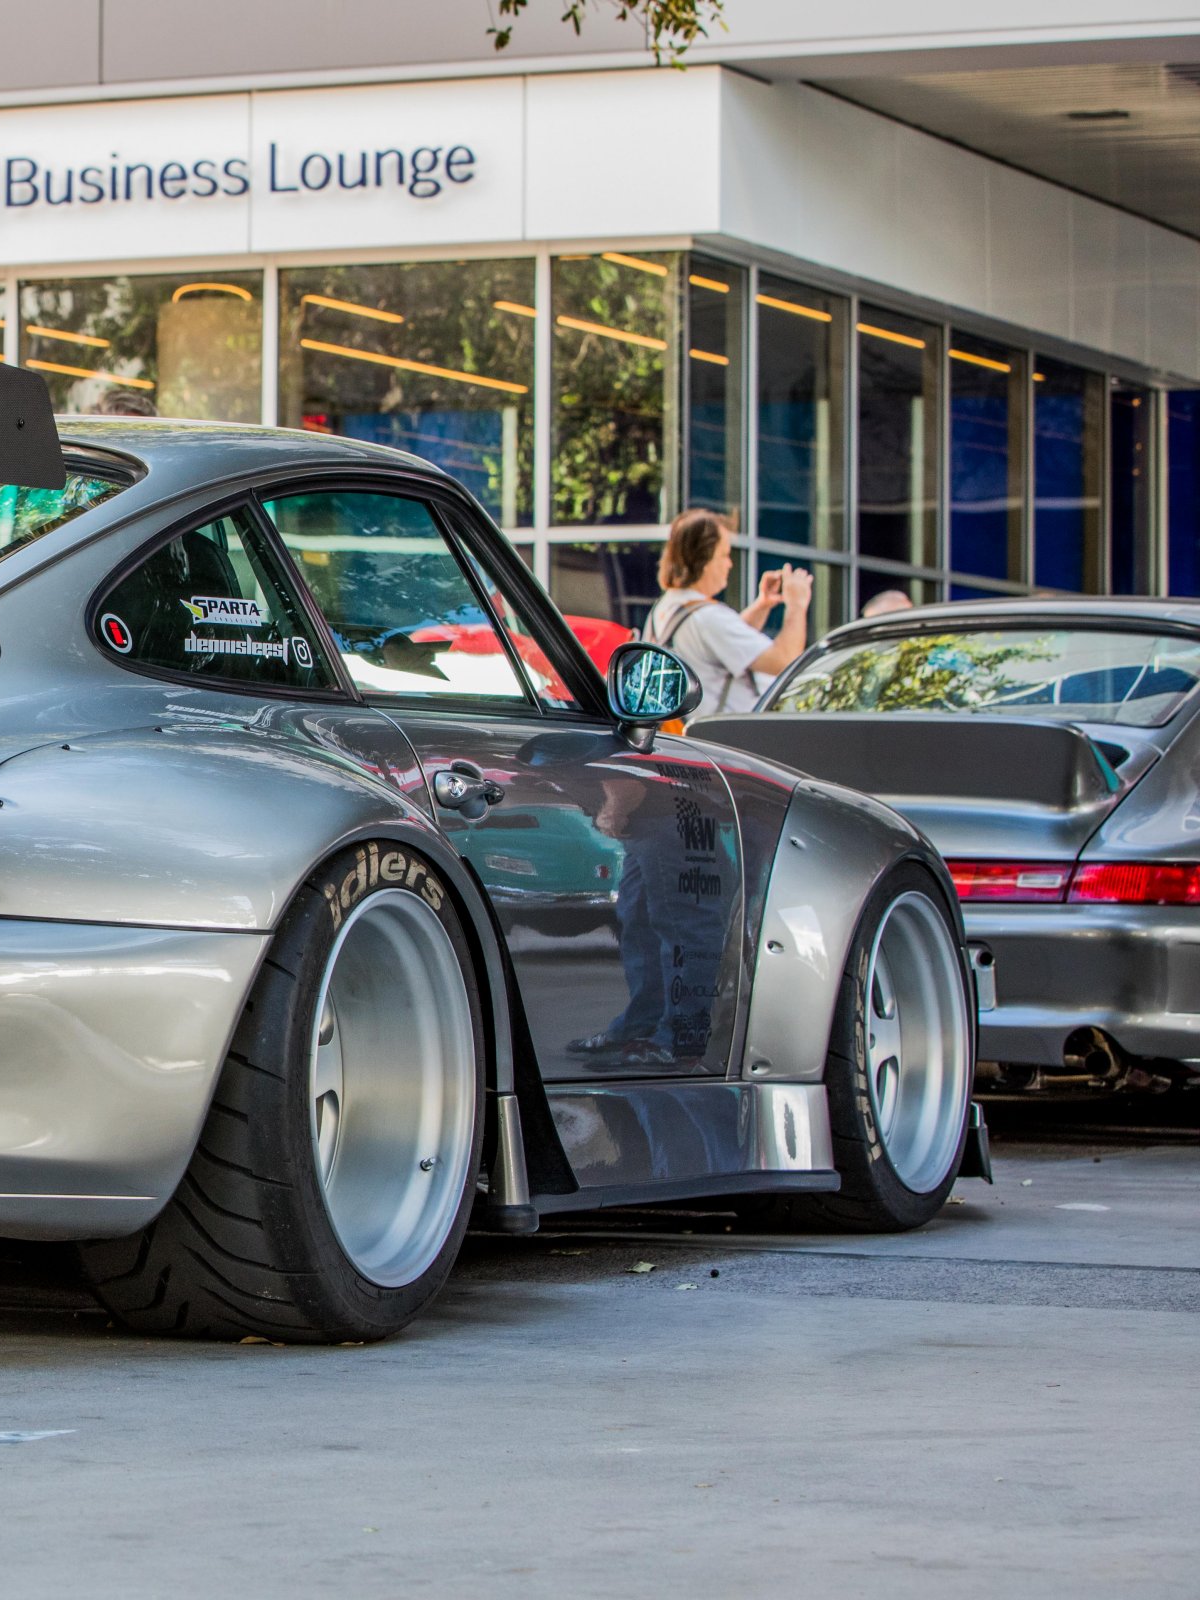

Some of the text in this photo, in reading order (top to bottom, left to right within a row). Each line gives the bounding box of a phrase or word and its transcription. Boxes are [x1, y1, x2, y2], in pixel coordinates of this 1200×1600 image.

[5, 153, 251, 207] Business
[269, 142, 477, 197] Lounge
[193, 599, 261, 621] SPARTA
[324, 841, 444, 932] idlers
[678, 866, 721, 904] rotiform
